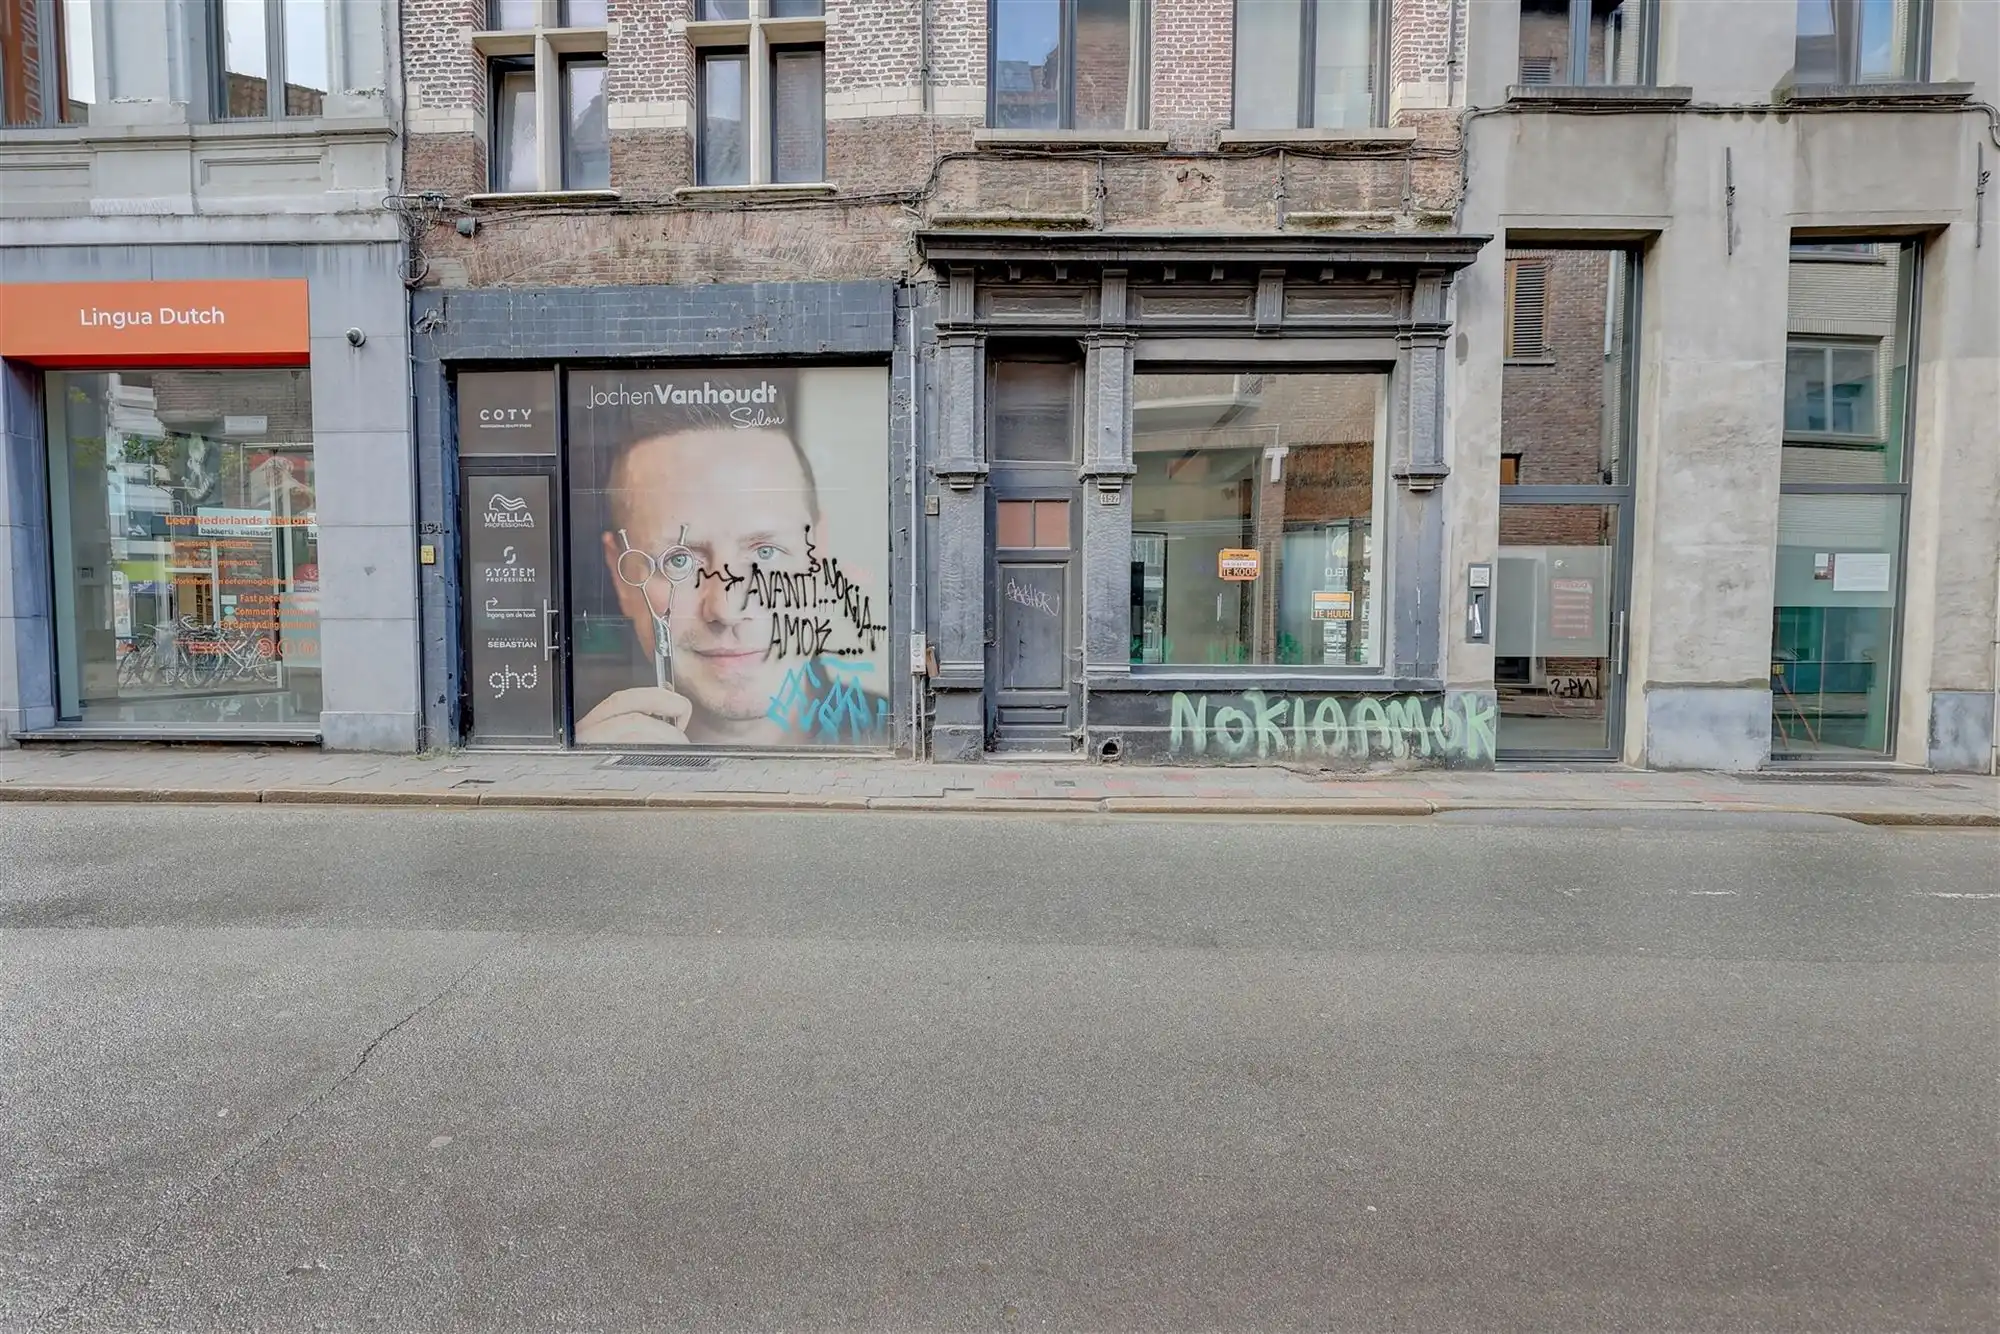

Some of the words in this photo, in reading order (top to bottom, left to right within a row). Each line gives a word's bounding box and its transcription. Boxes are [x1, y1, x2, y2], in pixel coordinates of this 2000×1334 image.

[80, 308, 153, 330] Lingua
[160, 306, 225, 325] Dutch
[479, 408, 532, 421] COTY
[729, 407, 784, 429] Salon
[483, 512, 534, 523] WELLA
[485, 568, 536, 577] SYSTEM
[1233, 568, 1257, 576] KOOP
[1314, 609, 1325, 618] TE
[1327, 609, 1351, 618] HUUR
[488, 664, 538, 699] ghd
